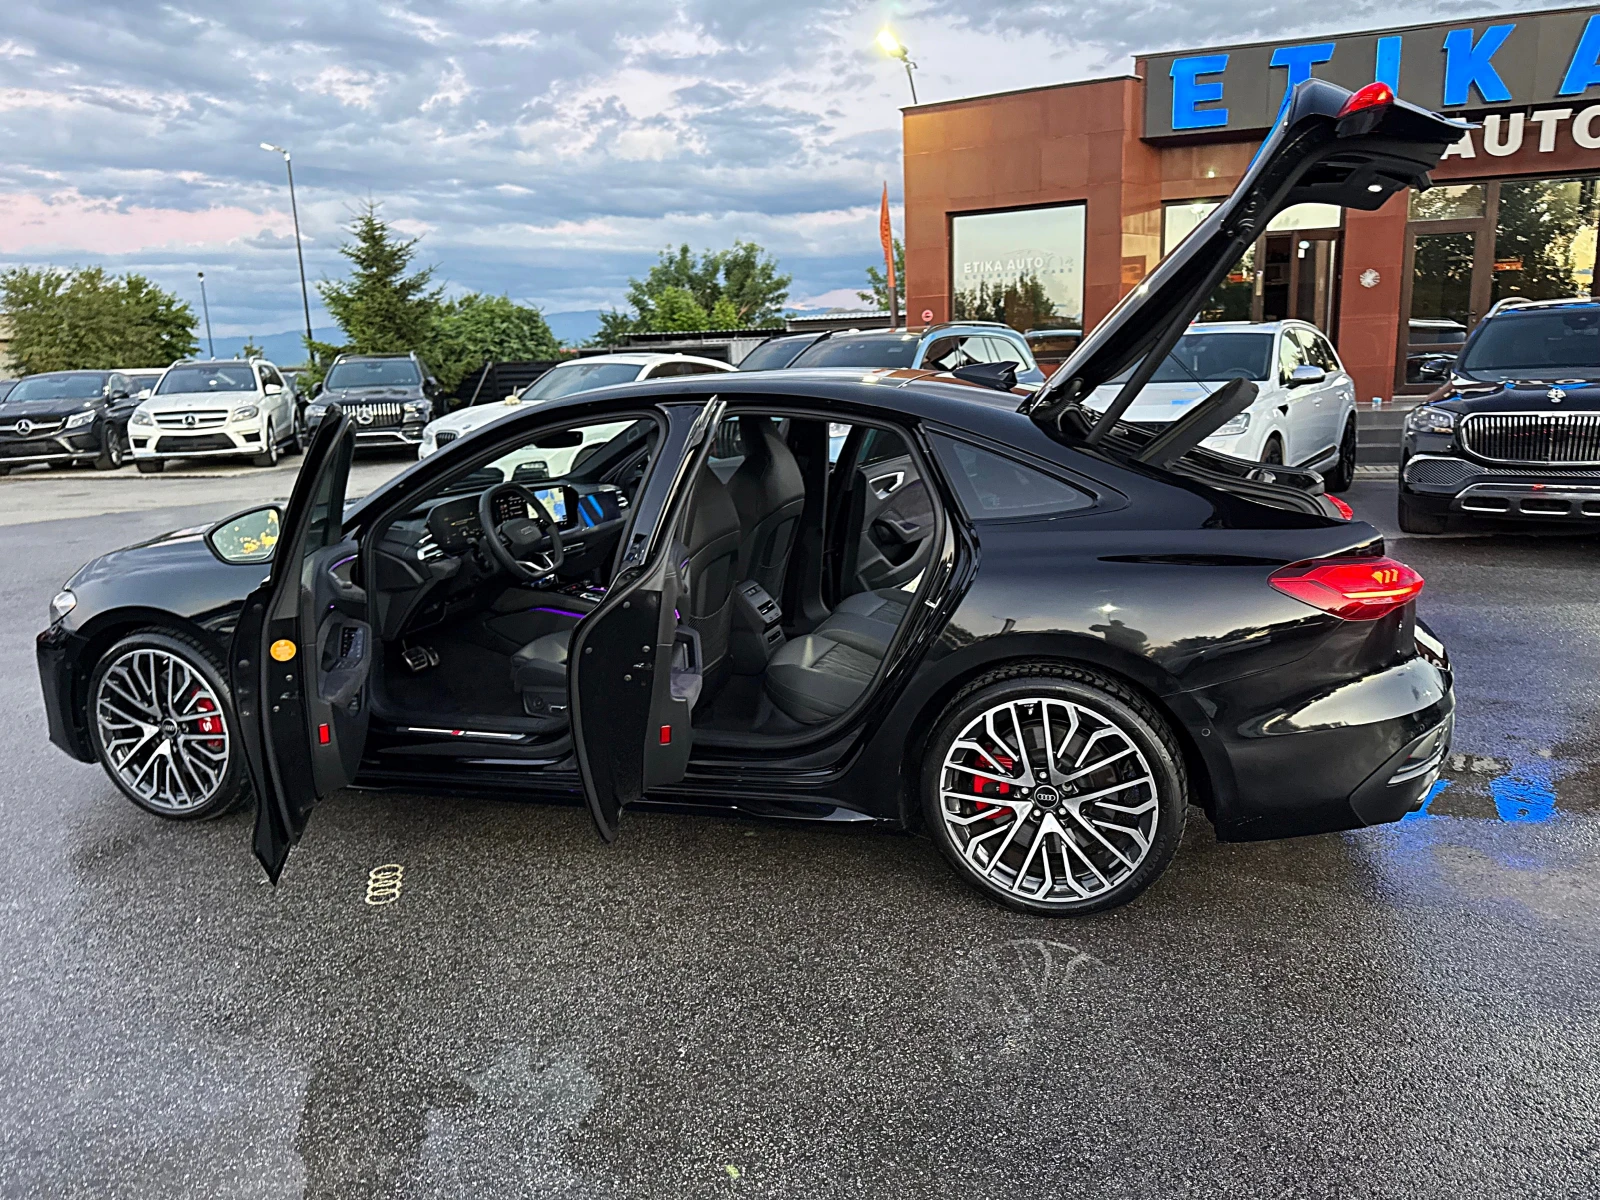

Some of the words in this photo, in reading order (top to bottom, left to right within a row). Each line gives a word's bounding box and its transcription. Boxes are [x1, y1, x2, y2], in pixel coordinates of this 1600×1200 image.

[1169, 14, 1600, 131] ETIKA
[1440, 105, 1600, 159] AUTO
[964, 260, 1003, 273] ETIKA
[1007, 257, 1044, 270] AUTO
